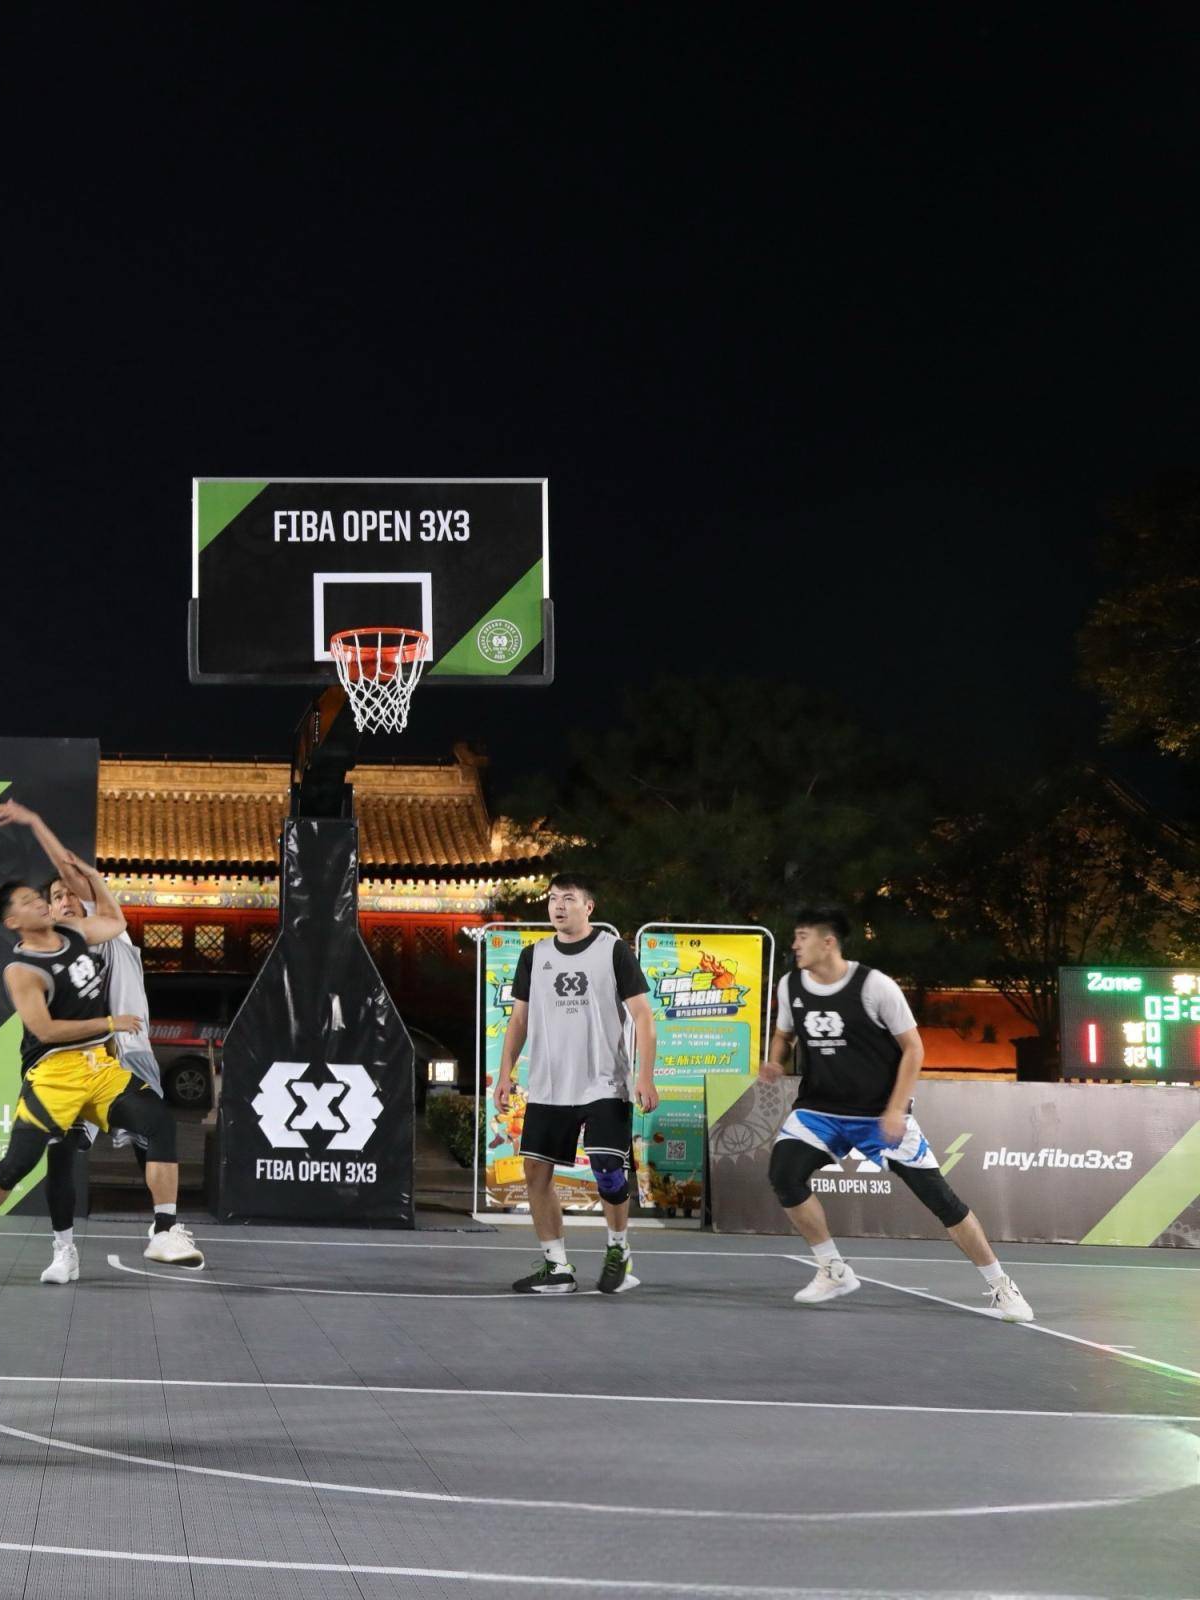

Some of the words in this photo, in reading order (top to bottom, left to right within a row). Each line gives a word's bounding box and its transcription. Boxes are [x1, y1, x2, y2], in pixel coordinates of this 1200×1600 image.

[274, 510, 336, 542] FIBA
[343, 510, 411, 542] OPEN
[419, 510, 470, 541] 3X3
[1087, 972, 1142, 992] Zone
[256, 1159, 294, 1181] FIBA
[299, 1161, 341, 1182] OPEN
[345, 1162, 377, 1183] 3X3
[983, 1147, 1133, 1171] play.fiba3x3
[811, 1178, 837, 1193] FIBA
[839, 1179, 867, 1193] OPEN
[870, 1180, 891, 1194] 3X3
